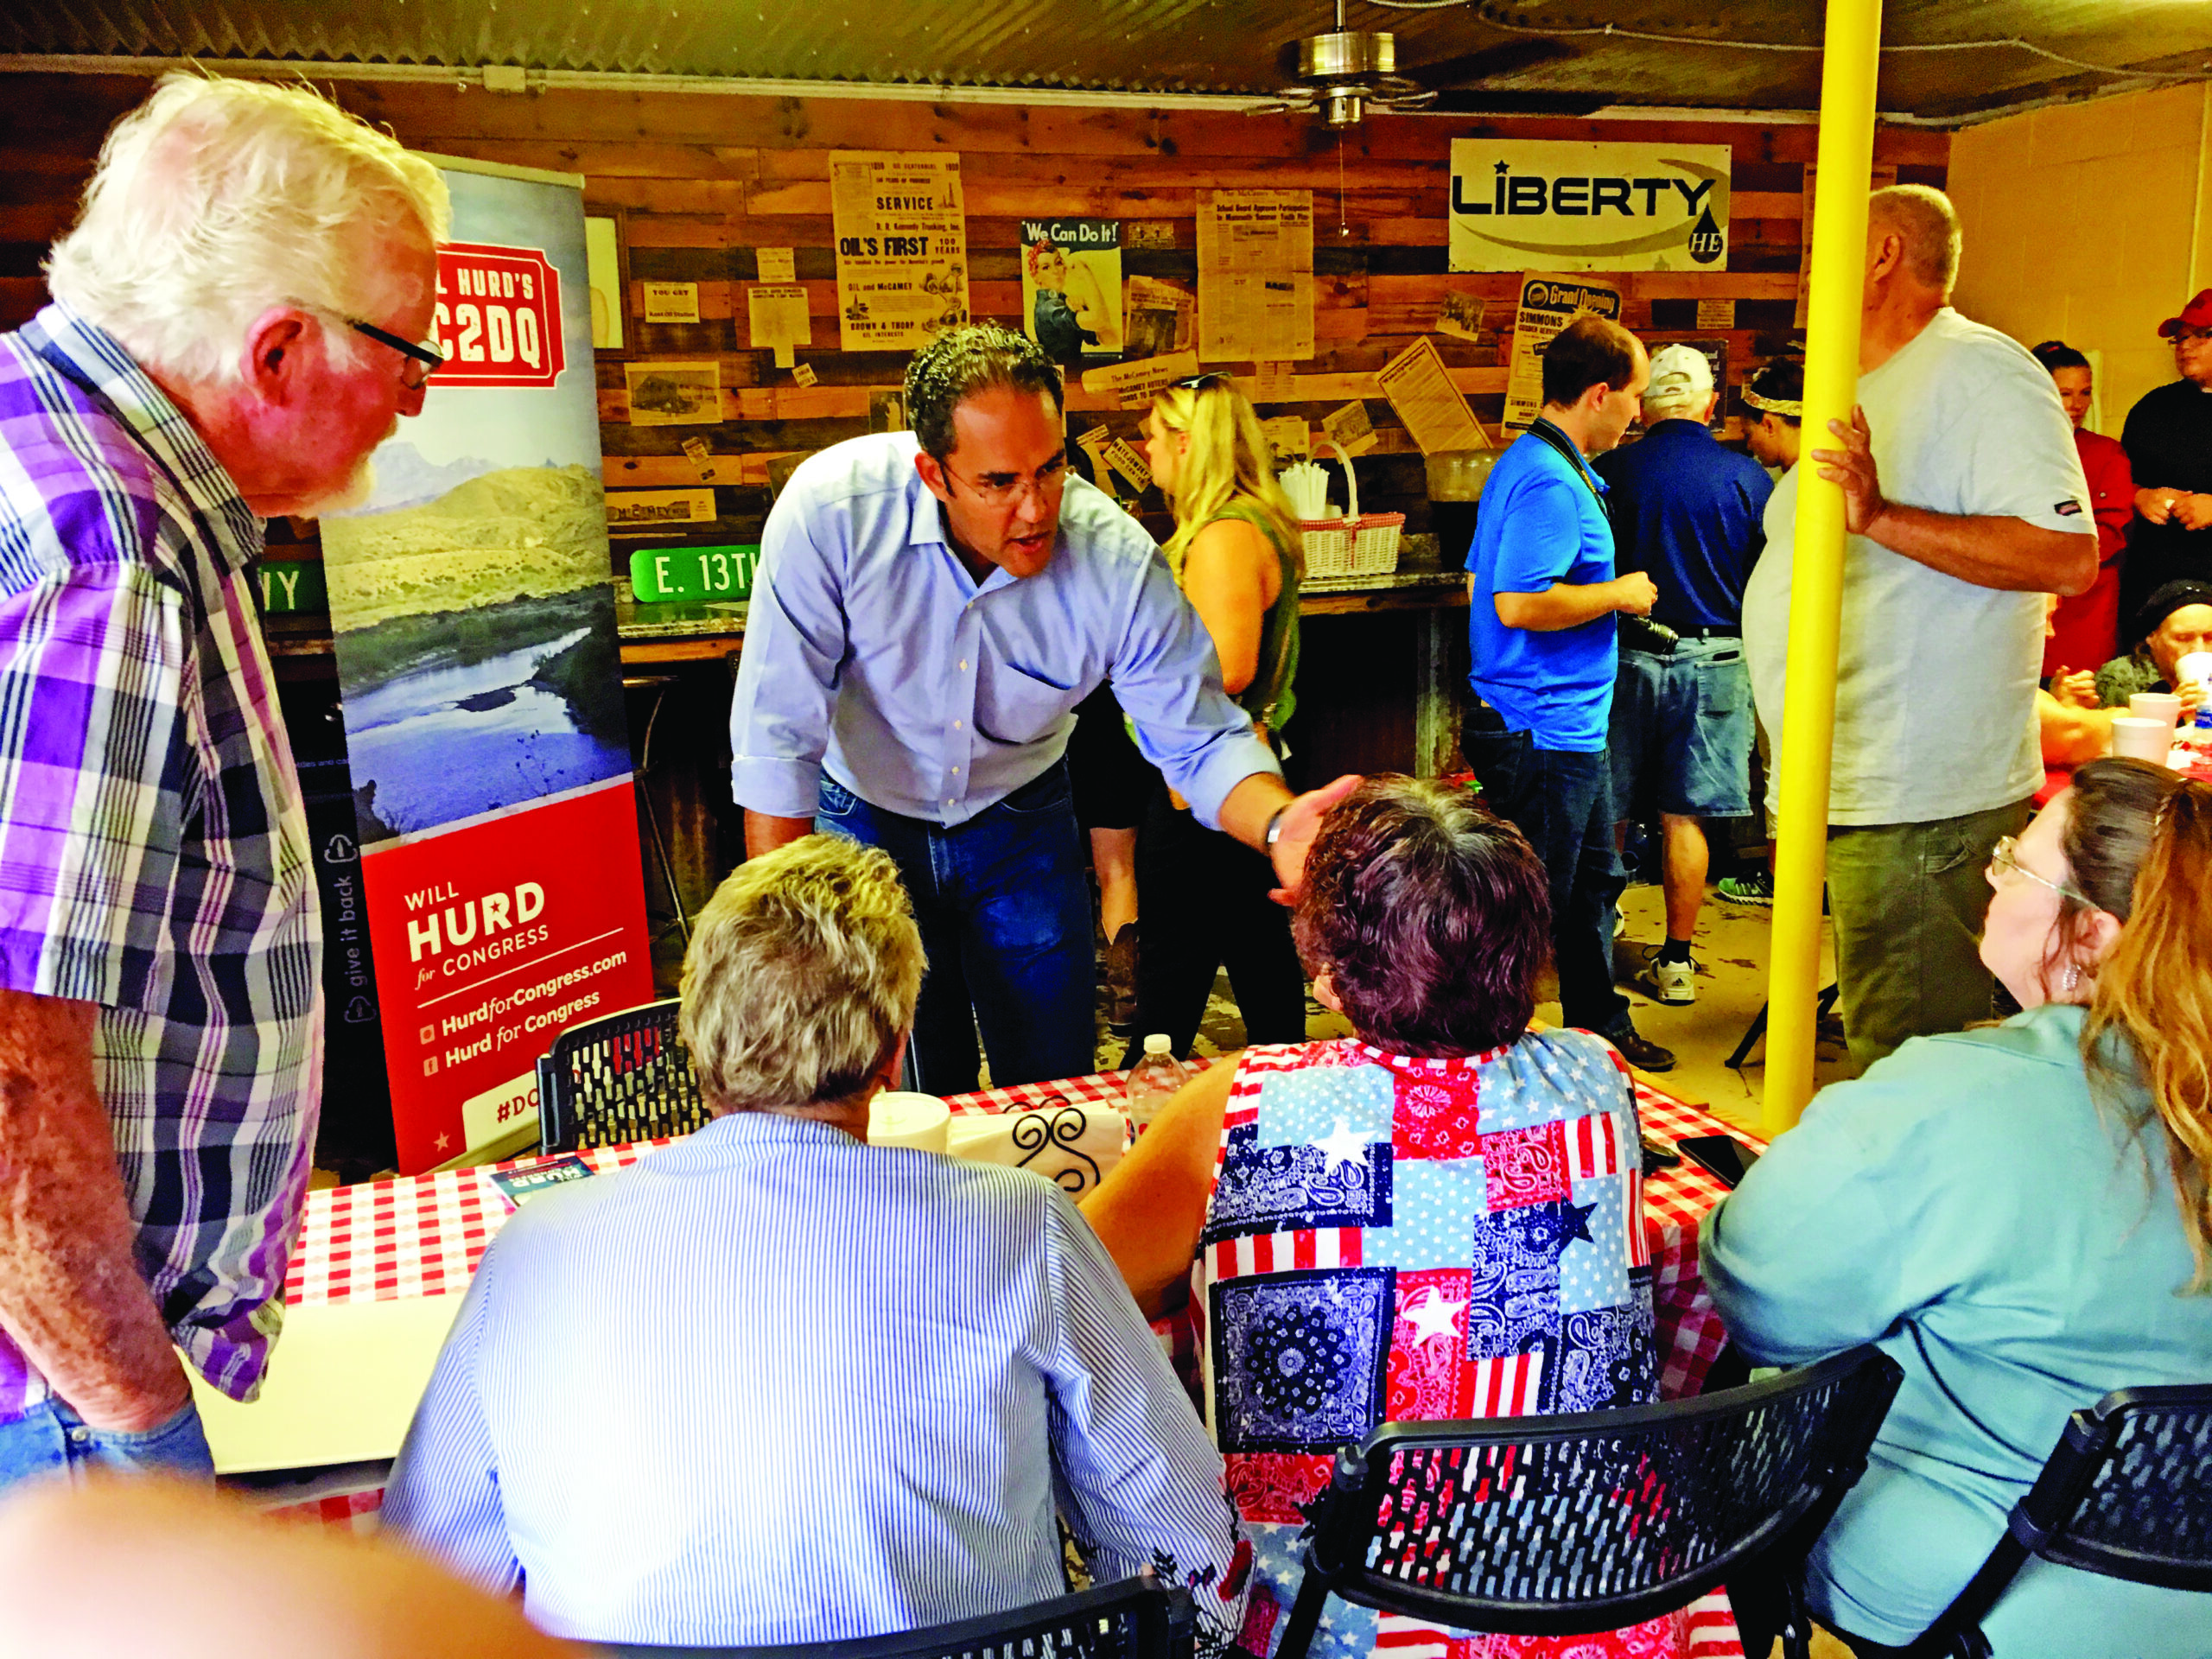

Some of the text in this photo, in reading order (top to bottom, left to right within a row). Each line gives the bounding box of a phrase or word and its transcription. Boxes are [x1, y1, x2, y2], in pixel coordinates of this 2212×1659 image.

[876, 196, 933, 210] SERVICE
[840, 237, 929, 257] OIL'S FIRST
[1051, 223, 1077, 241] Can
[1079, 224, 1098, 241] Do
[457, 268, 534, 300] HURD'S
[1550, 284, 1615, 315] Grand Opening
[850, 322, 876, 331] BROWN
[1519, 311, 1563, 327] SIMMONS
[655, 556, 684, 594] E.
[404, 881, 459, 912] WILL
[334, 875, 368, 987] give it back
[407, 881, 545, 963] HURD
[415, 925, 549, 991] for CONGRESS
[442, 951, 627, 1037] HurdforCongress.com
[445, 991, 601, 1068] Hurd for Congress
